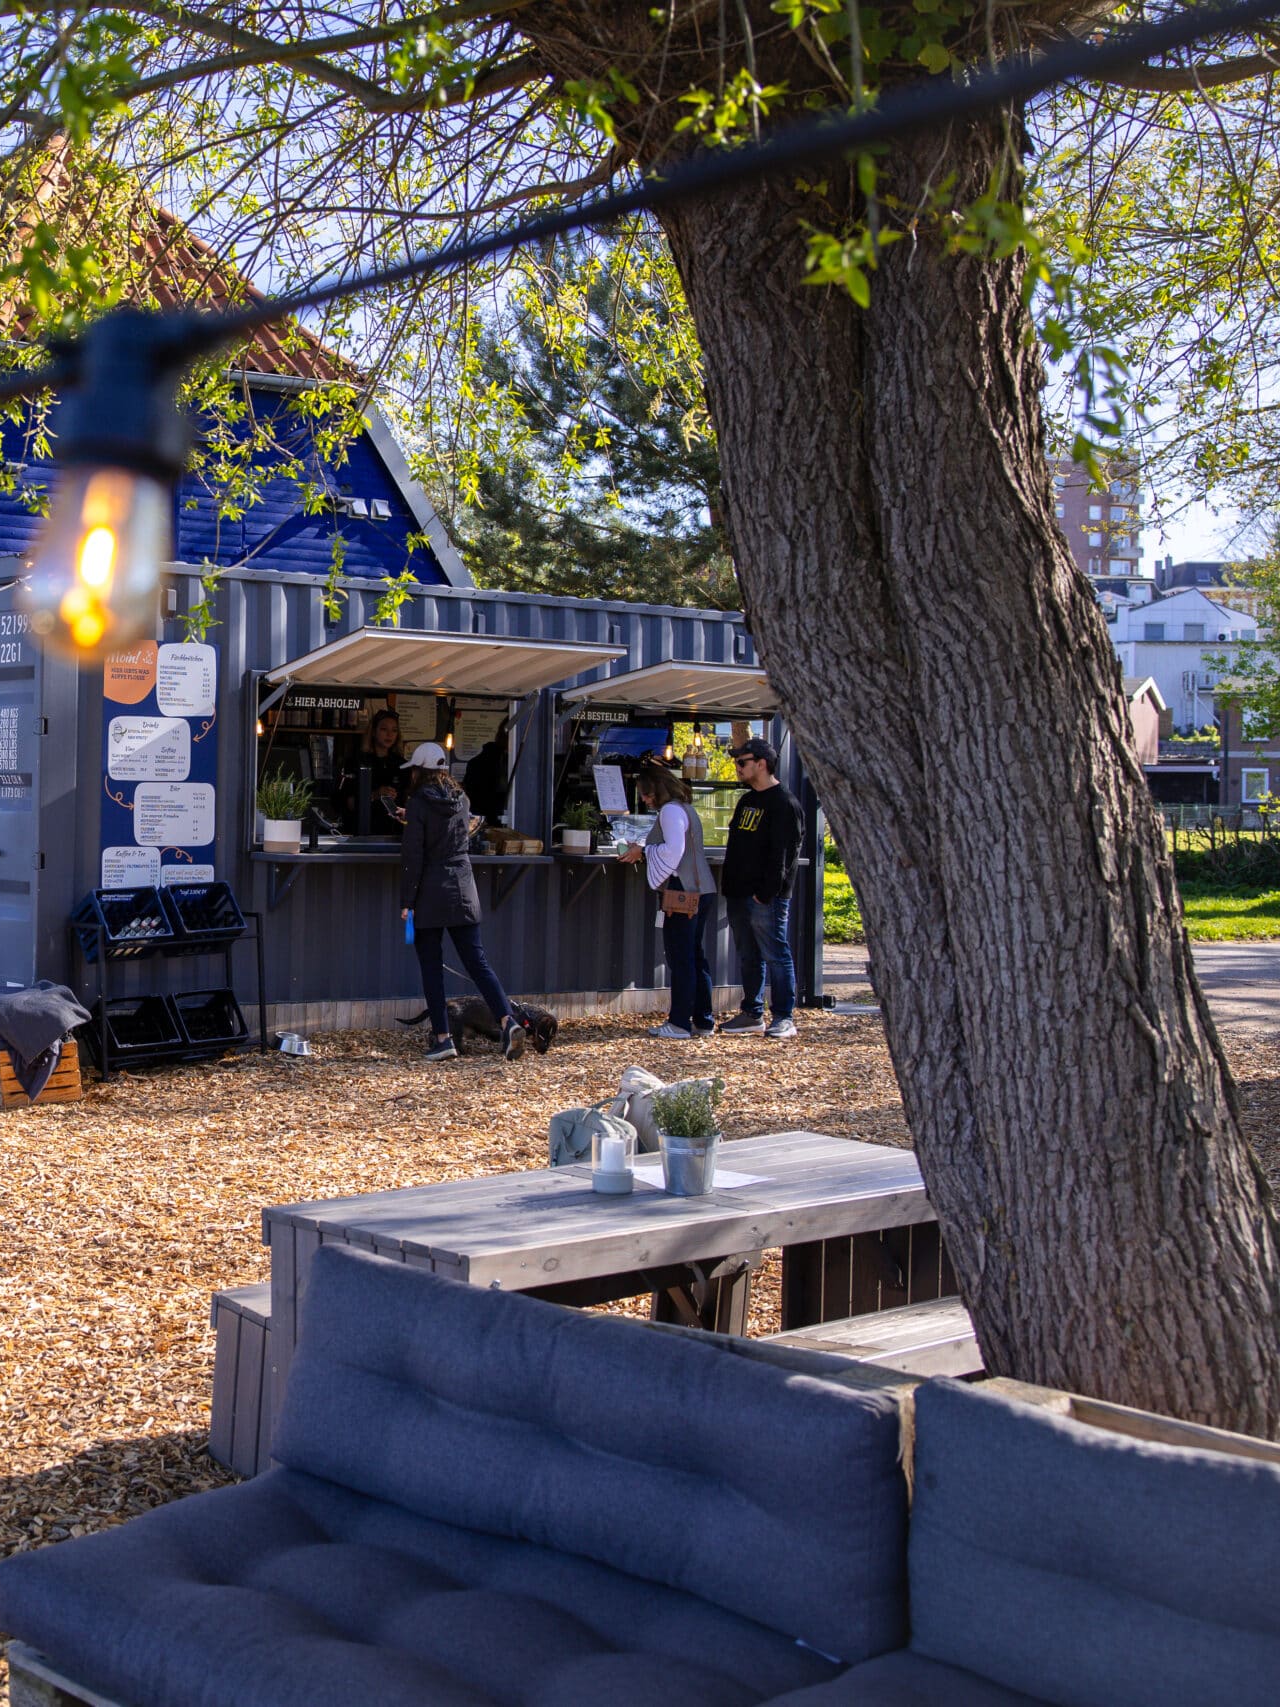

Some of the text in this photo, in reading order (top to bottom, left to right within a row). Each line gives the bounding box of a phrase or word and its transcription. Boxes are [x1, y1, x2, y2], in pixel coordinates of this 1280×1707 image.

[1, 643, 21, 663] 22G1
[295, 697, 360, 709] HIER ABHOLEN
[587, 711, 629, 722] BESTELLEN
